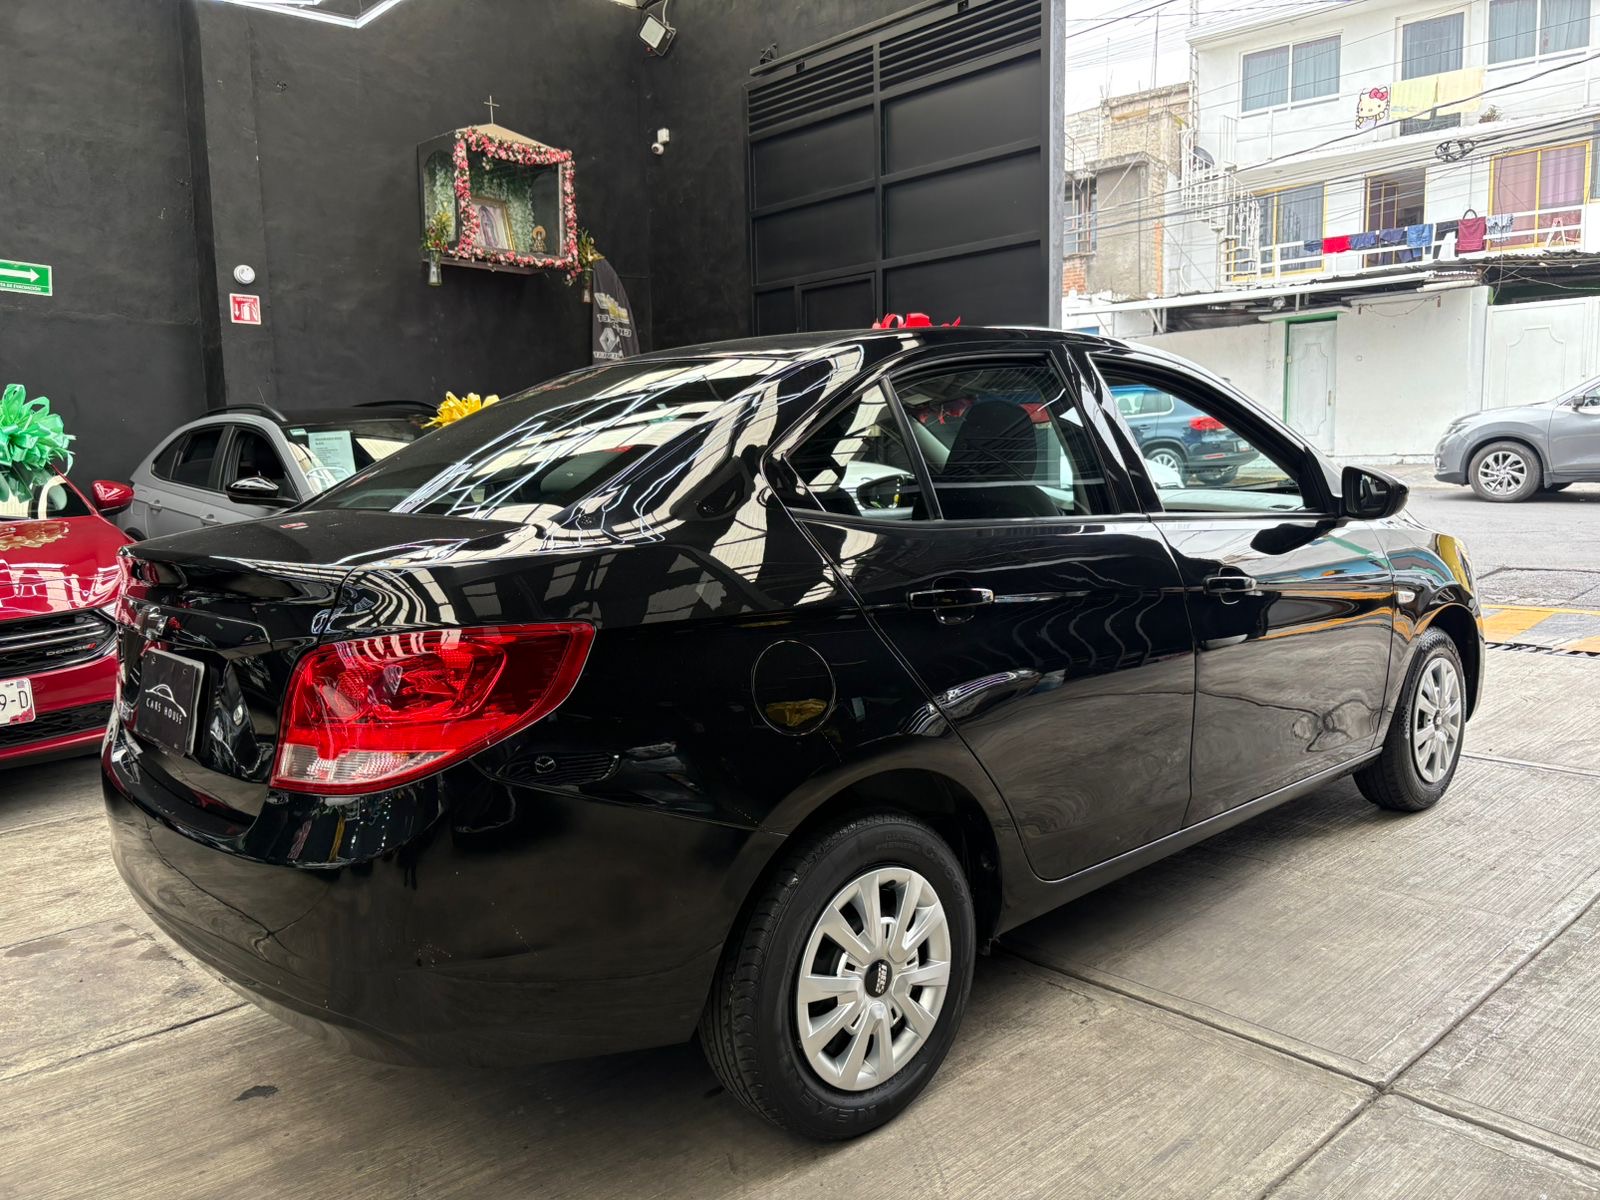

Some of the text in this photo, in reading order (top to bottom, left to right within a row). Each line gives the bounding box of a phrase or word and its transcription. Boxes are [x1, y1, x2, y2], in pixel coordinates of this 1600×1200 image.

[46, 645, 88, 656] DODGE
[146, 698, 161, 713] CARS
[164, 707, 183, 725] HOUSE
